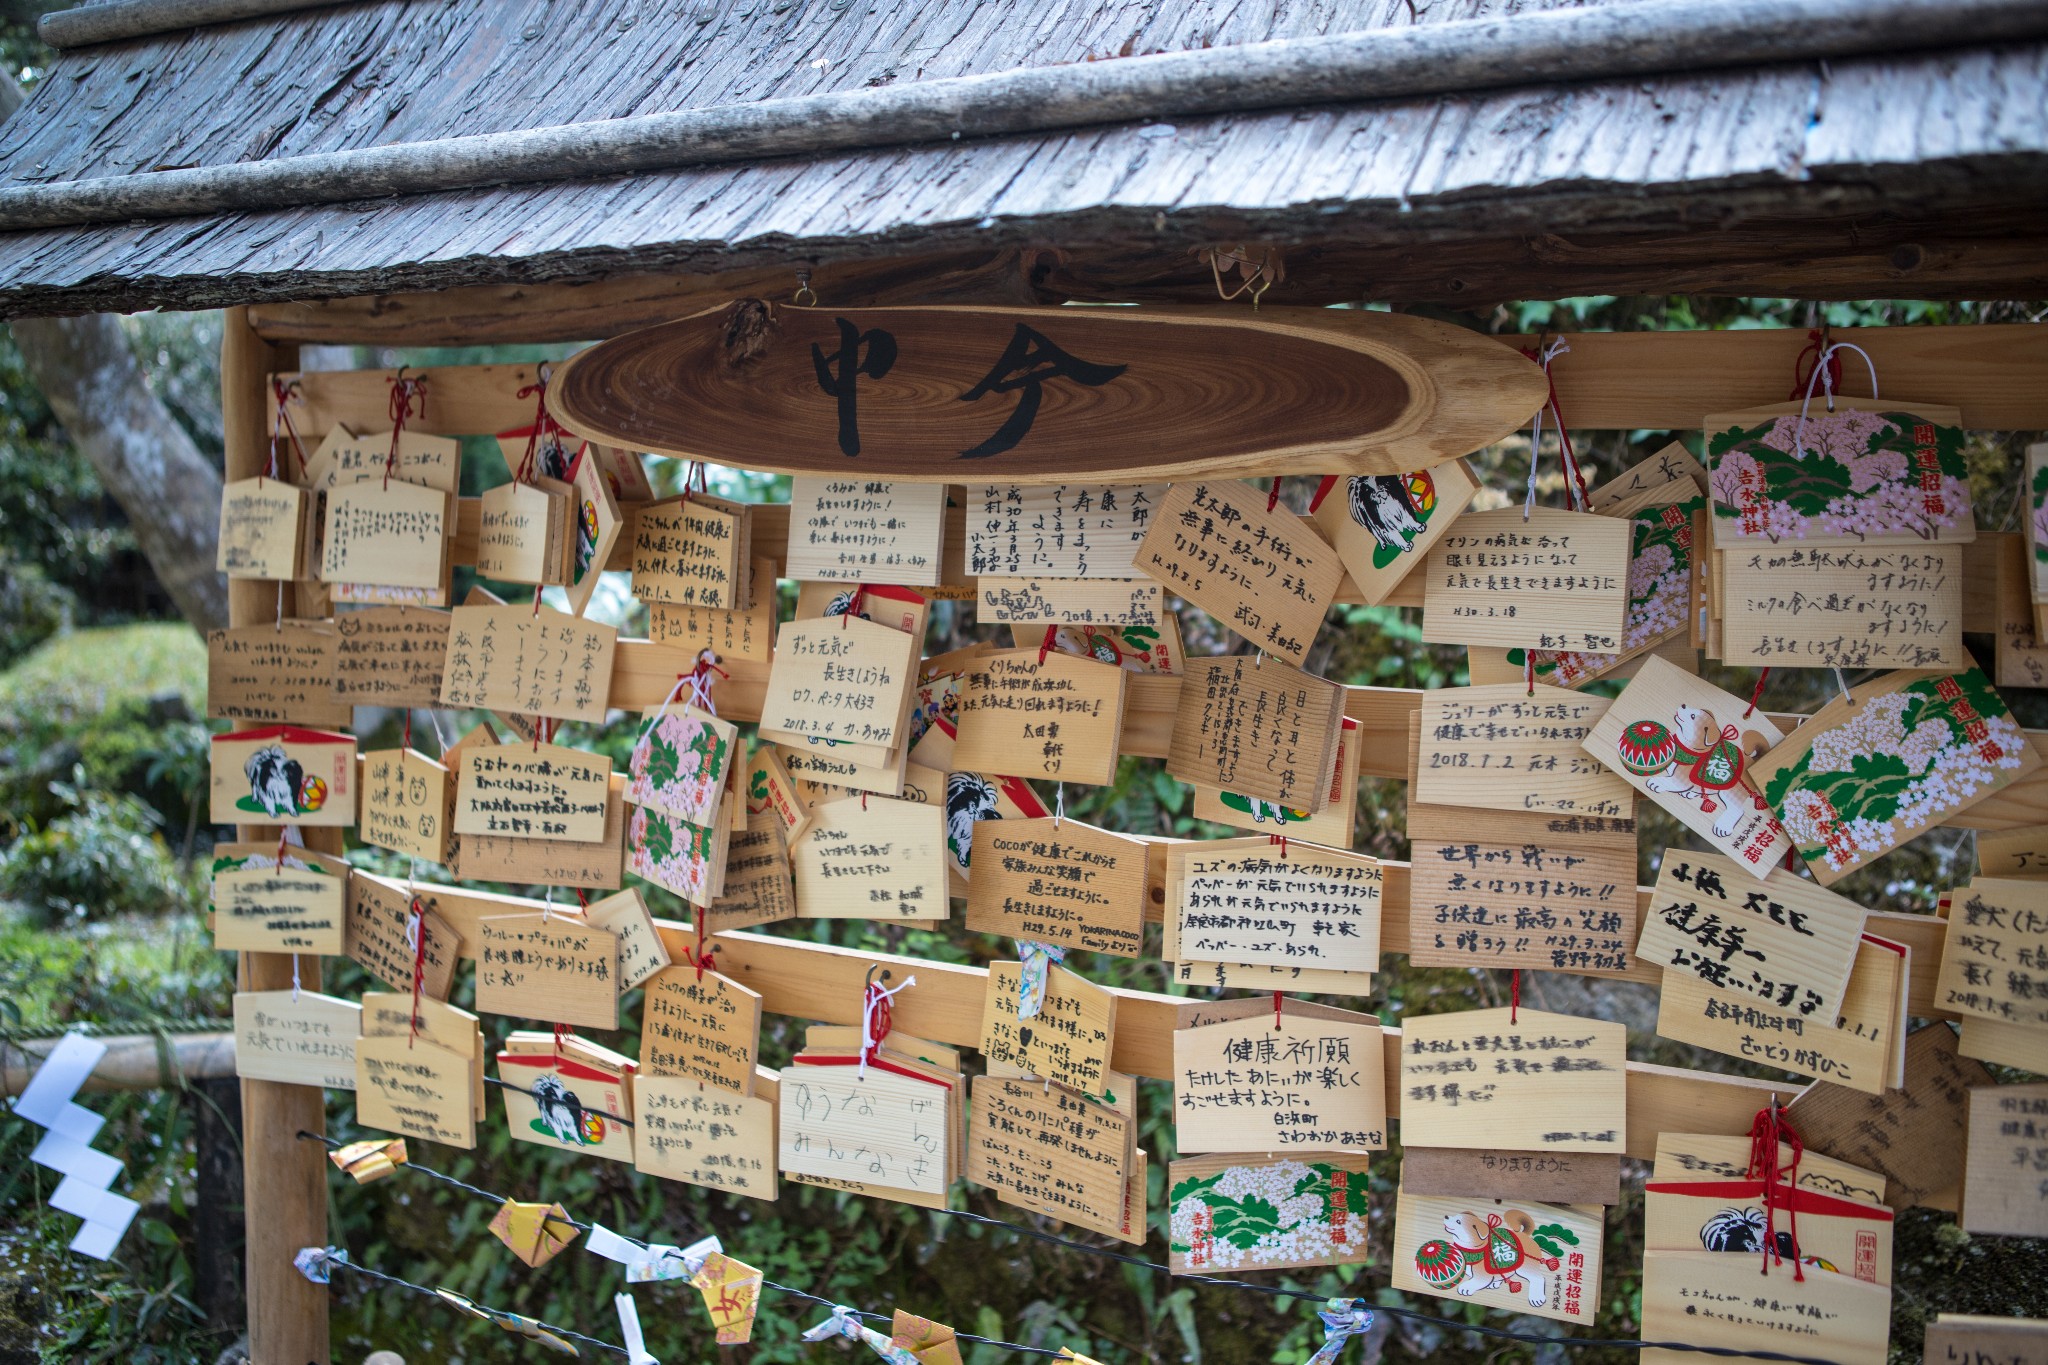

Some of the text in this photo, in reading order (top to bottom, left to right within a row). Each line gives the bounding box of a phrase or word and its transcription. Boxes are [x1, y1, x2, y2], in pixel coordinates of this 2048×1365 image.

[1914, 424, 1945, 516] 開運招福
[1738, 469, 1761, 536] 吉水神社
[1935, 676, 2004, 764] 開運招福
[1708, 757, 1731, 782] 福
[1808, 804, 1853, 866] 吉水神社
[1191, 1212, 1205, 1265] 吉水神社
[1330, 1171, 1348, 1244] 開運招福
[1492, 1243, 1516, 1263] 福
[1564, 1252, 1584, 1316] 開運招福
